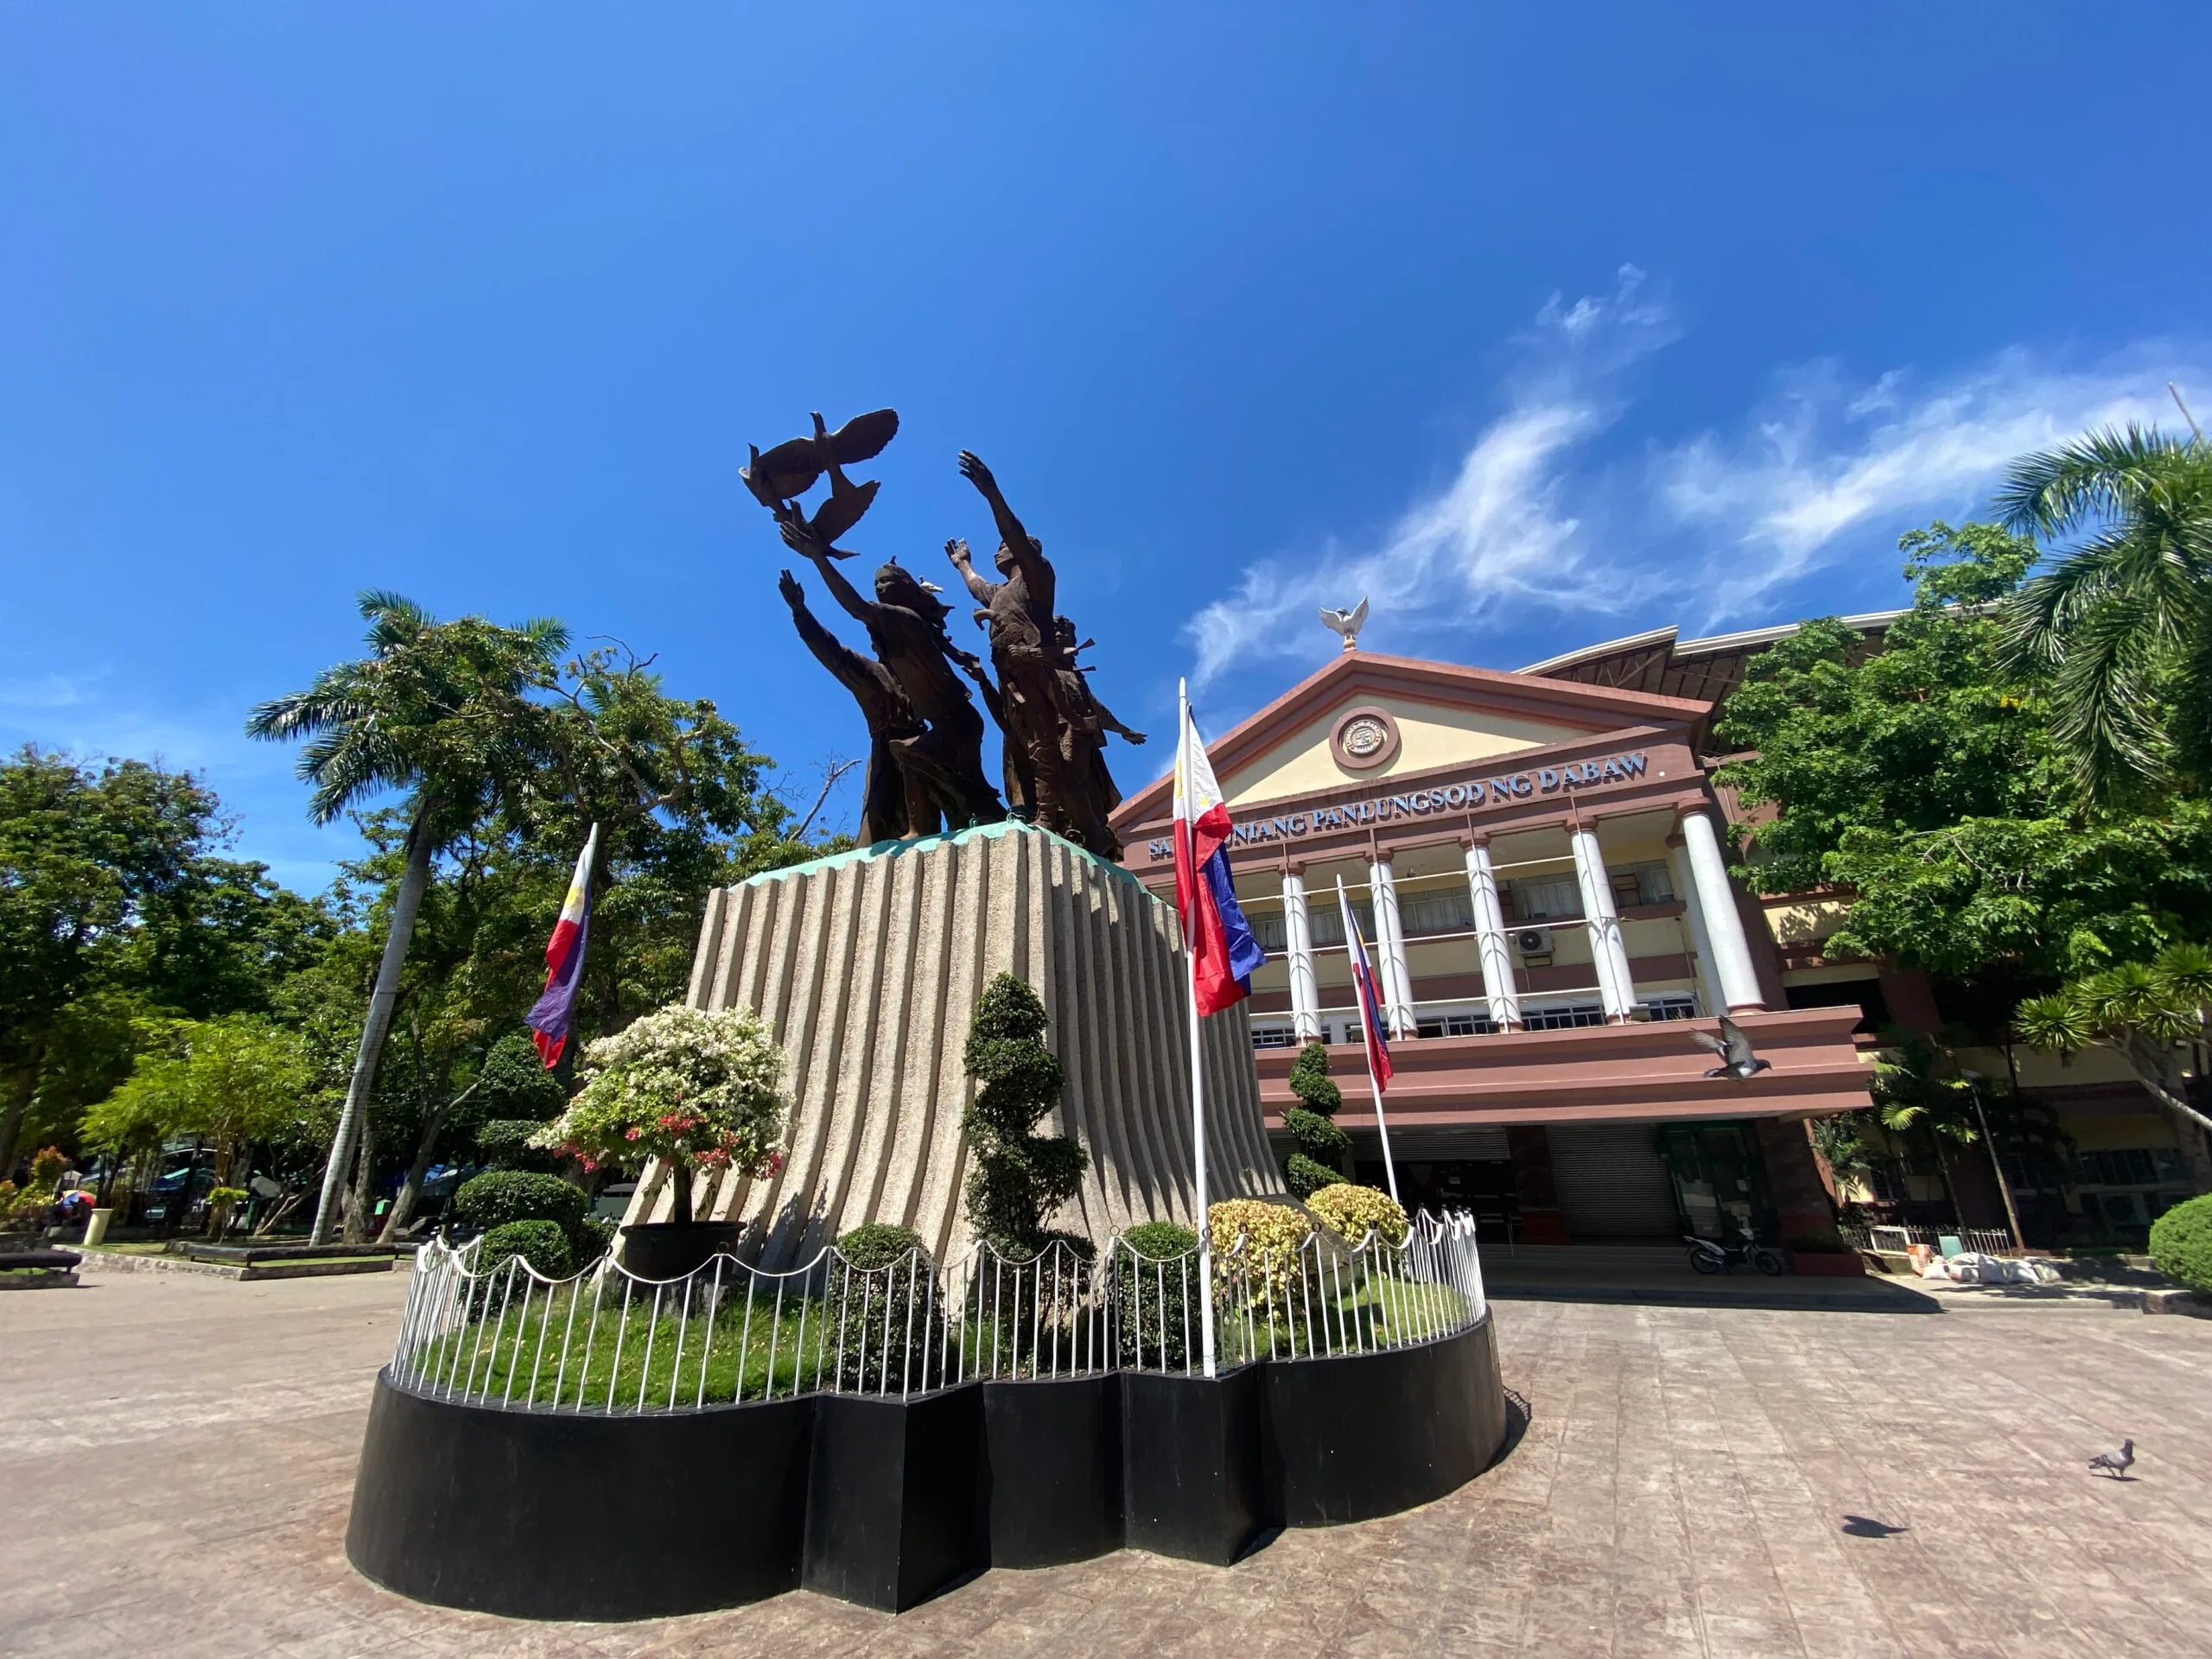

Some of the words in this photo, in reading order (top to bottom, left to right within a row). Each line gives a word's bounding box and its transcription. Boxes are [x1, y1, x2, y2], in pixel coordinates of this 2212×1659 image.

[1147, 815, 1306, 856] SANIANG
[1312, 783, 1485, 828] PANLUNGSOD
[1490, 774, 1532, 798] NG
[1538, 751, 1647, 788] DABAW
